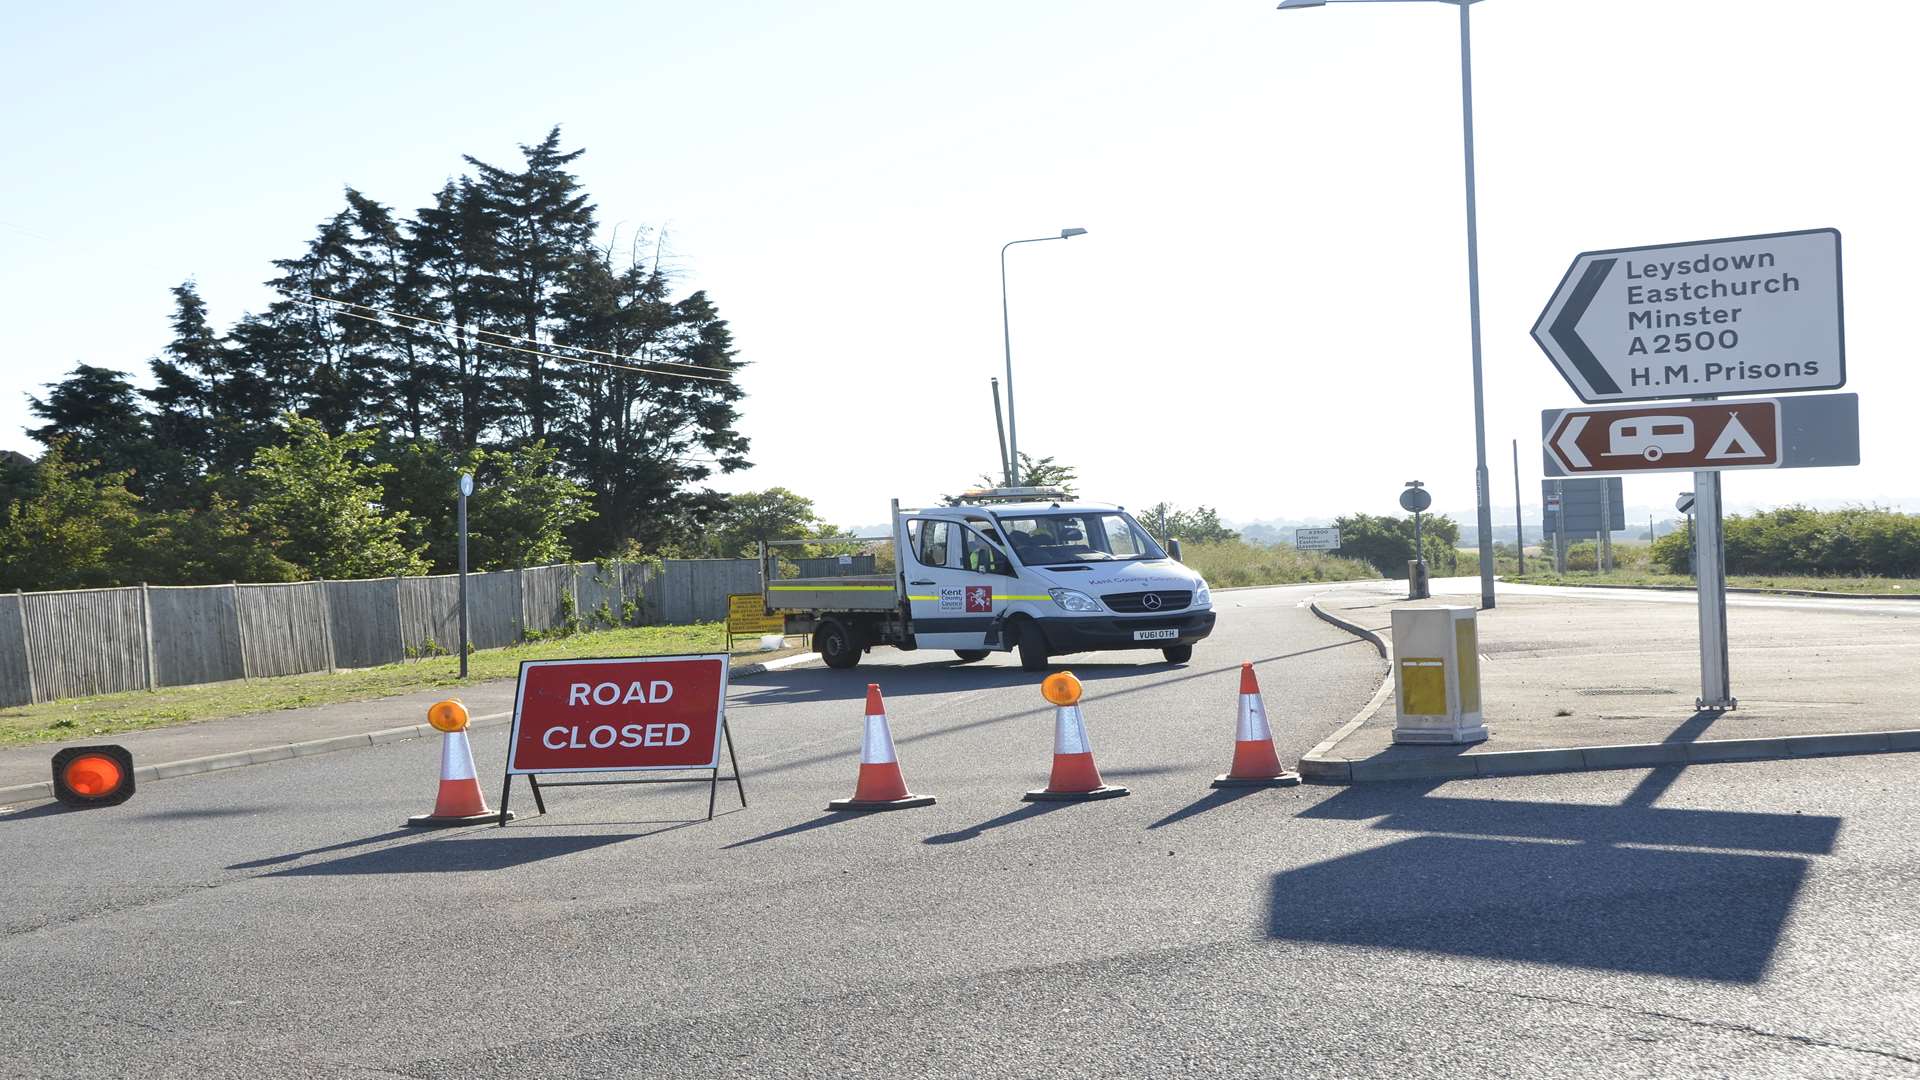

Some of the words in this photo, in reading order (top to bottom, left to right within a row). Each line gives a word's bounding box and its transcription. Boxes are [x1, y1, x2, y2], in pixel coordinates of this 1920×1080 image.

[1626, 251, 1775, 281] Leysdown
[1627, 272, 1800, 305] Eastchurch
[1628, 306, 1742, 331] Minster
[1628, 329, 1739, 356] A2500
[941, 588, 962, 596] Kent
[1139, 631, 1158, 639] VU61
[1158, 630, 1175, 638] OTH
[568, 679, 674, 706] ROAD
[542, 722, 691, 750] CLOSED
